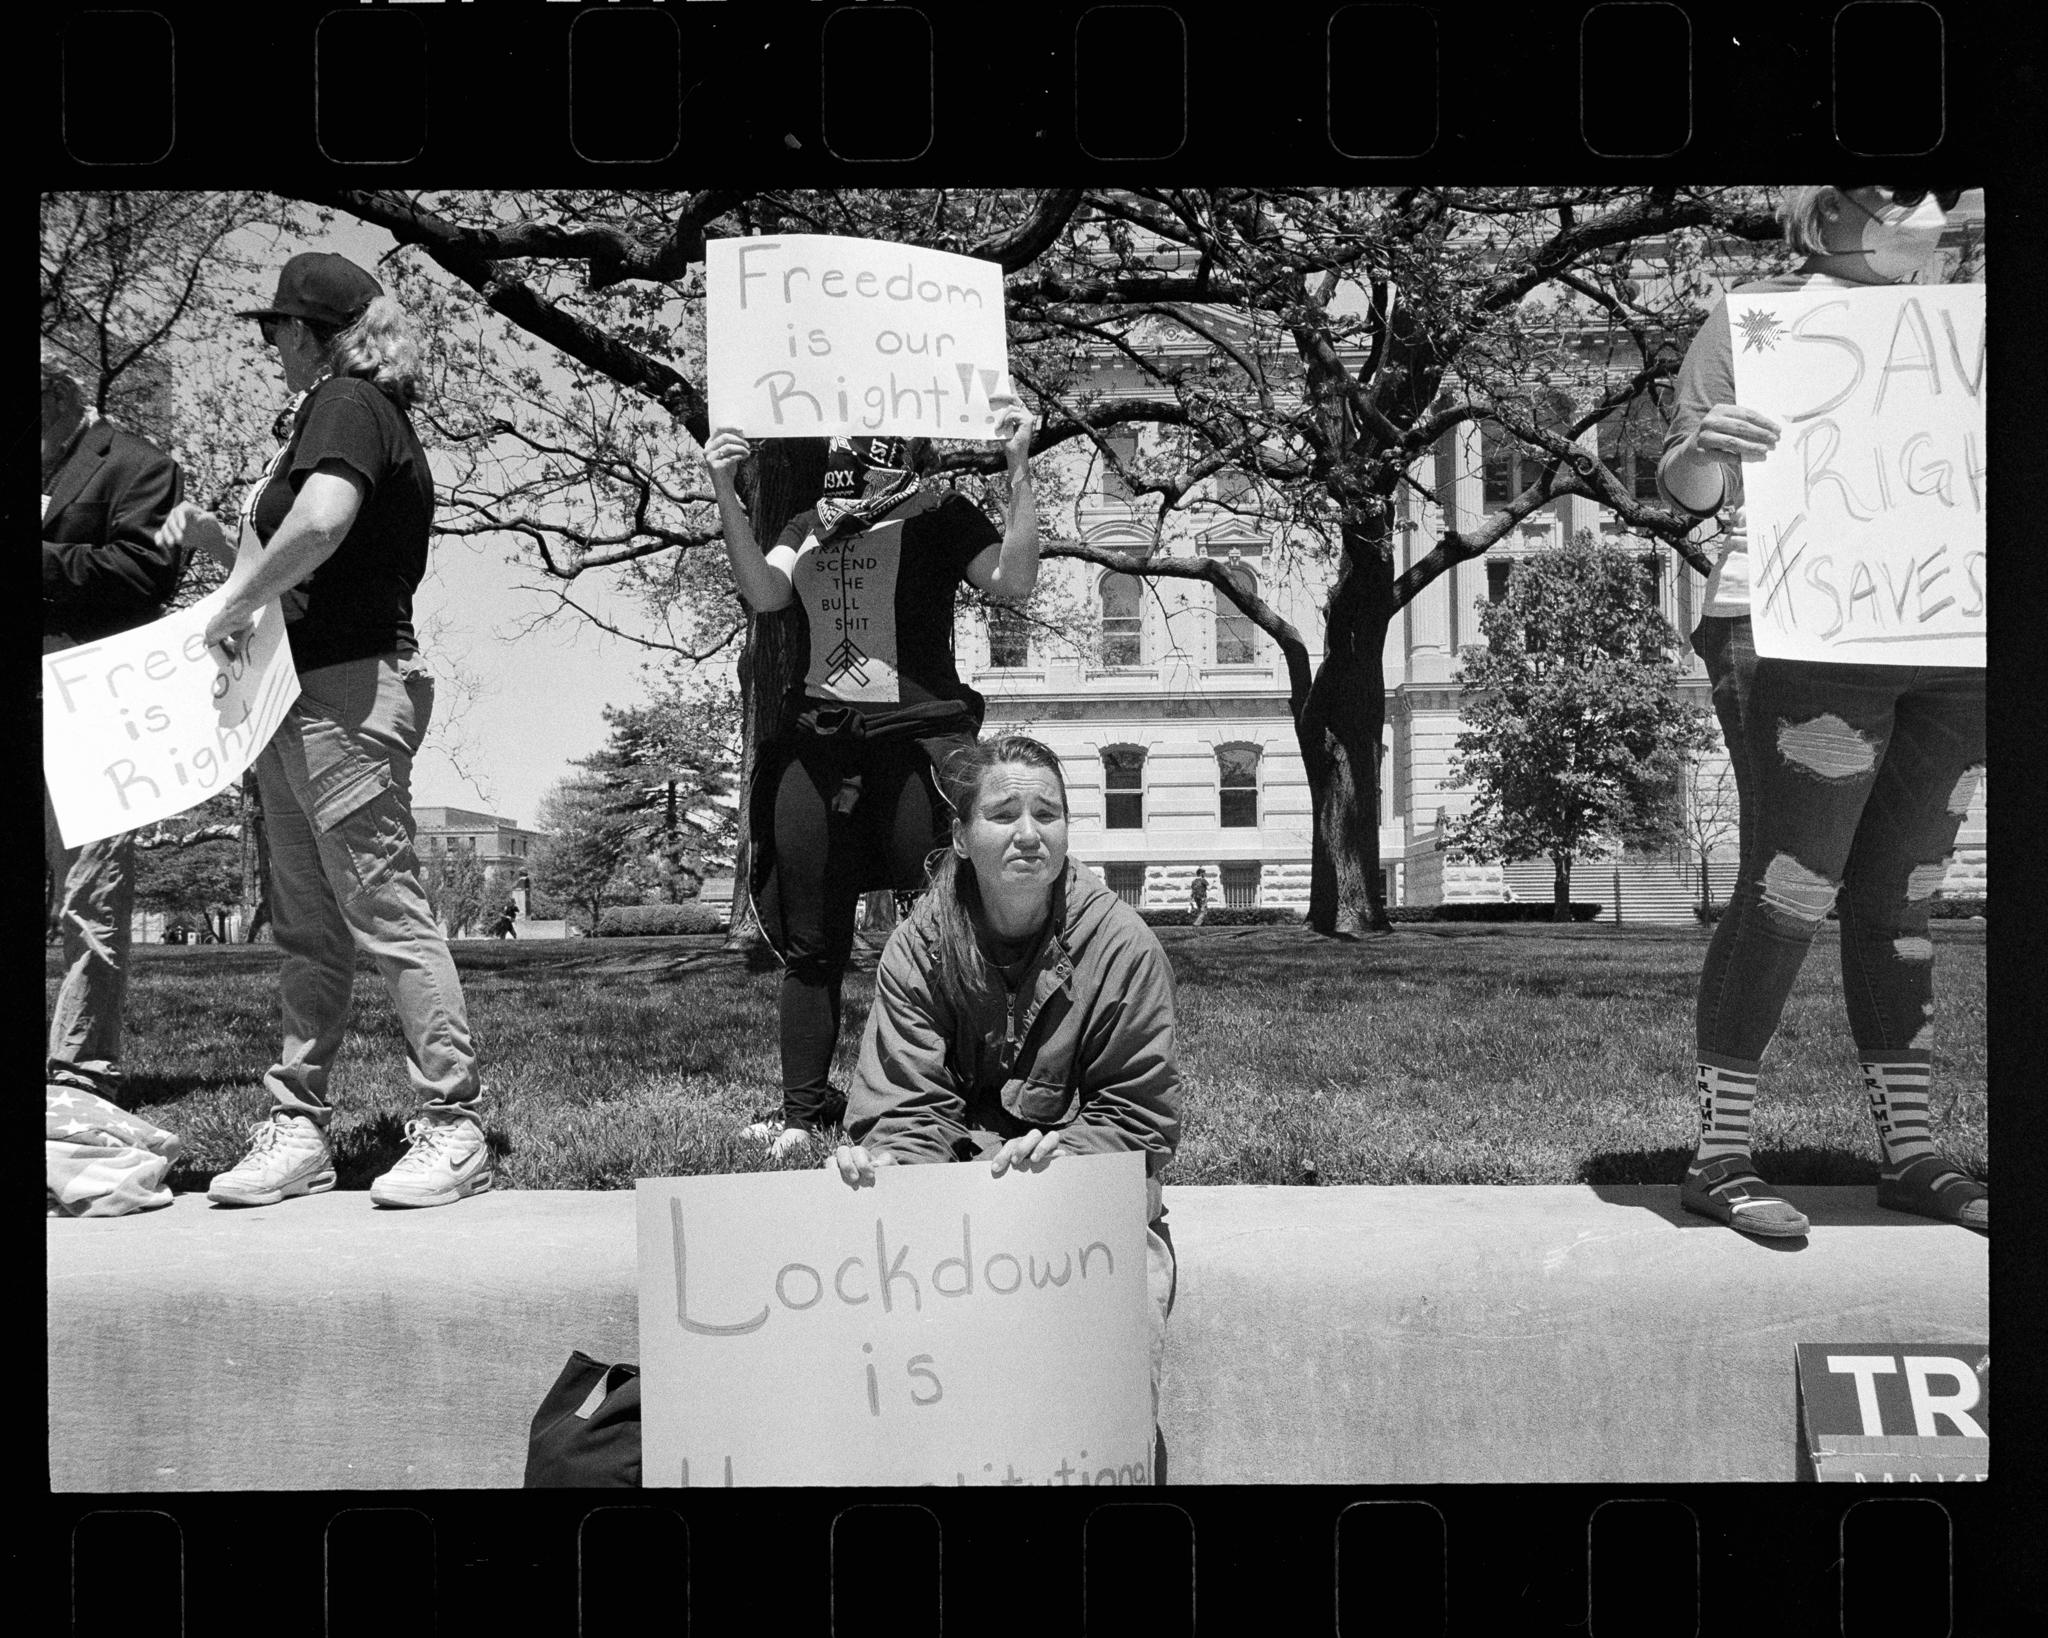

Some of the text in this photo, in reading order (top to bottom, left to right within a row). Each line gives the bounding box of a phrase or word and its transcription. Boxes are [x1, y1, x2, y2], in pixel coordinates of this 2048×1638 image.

[737, 243, 983, 310] Freedom
[786, 323, 955, 358] is our
[815, 557, 877, 572] SCEND
[832, 577, 864, 590] THE
[821, 598, 860, 612] BULL
[835, 617, 870, 631] SHIT
[120, 705, 171, 742] is
[1861, 1063, 1893, 1138] TRUMP
[670, 1196, 1115, 1337] Lockdown
[862, 1341, 944, 1416] is
[1827, 1355, 1989, 1438] TR
